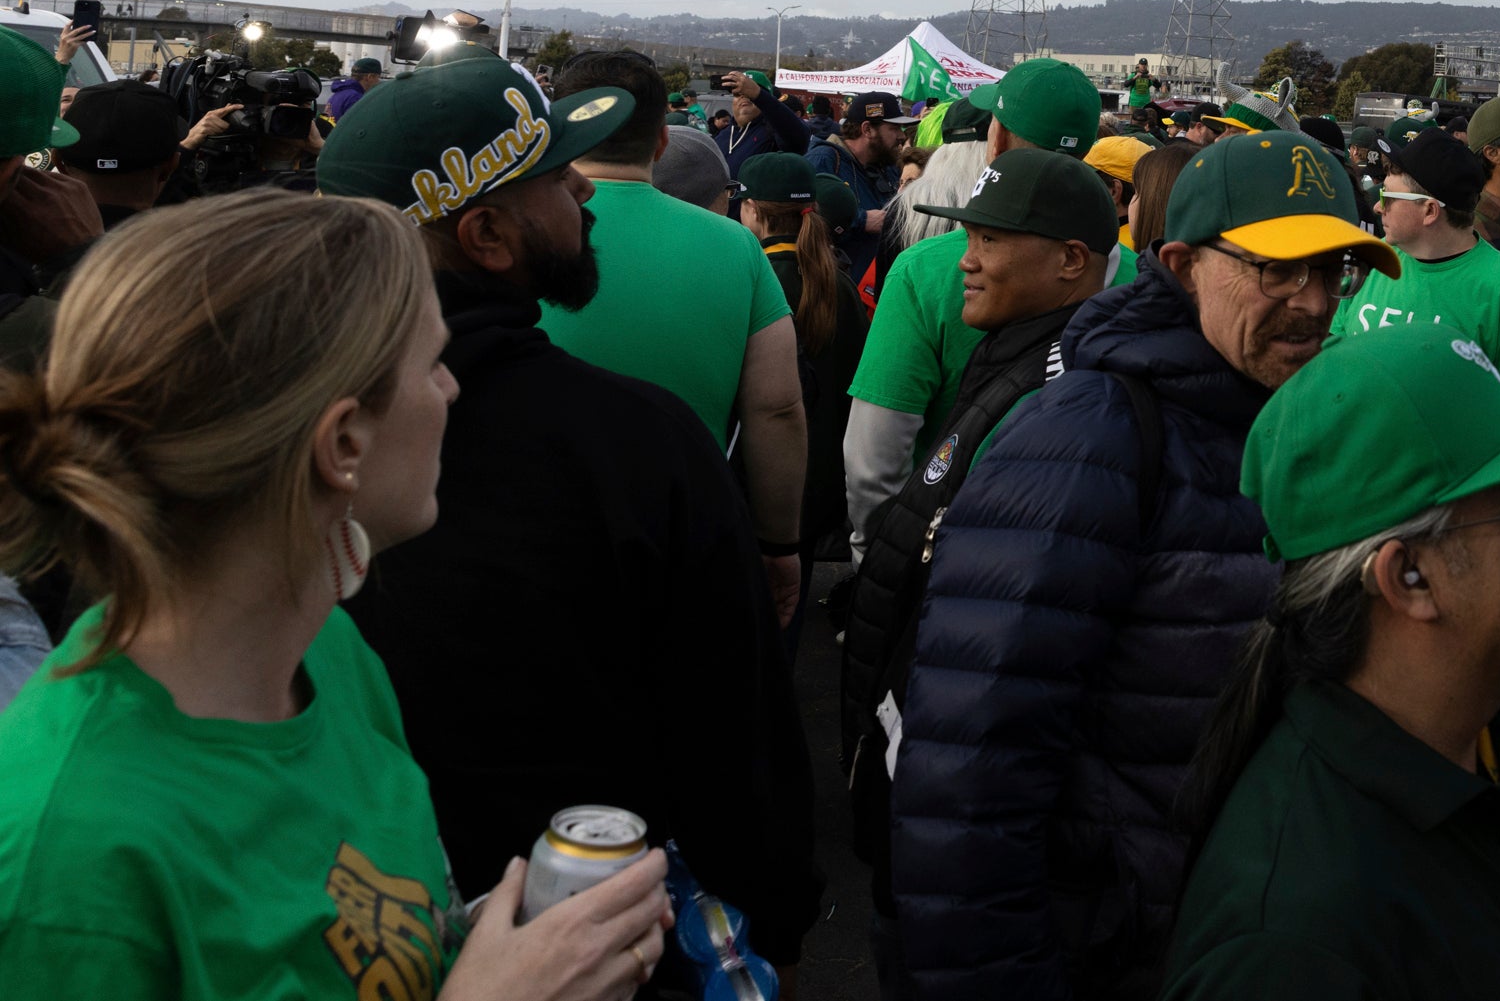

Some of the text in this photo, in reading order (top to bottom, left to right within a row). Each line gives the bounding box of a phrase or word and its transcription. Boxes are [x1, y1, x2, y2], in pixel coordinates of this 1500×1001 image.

[785, 73, 828, 83] CALIFORNIA
[829, 75, 846, 84] BBQ
[847, 76, 893, 87] ASSOCIATION
